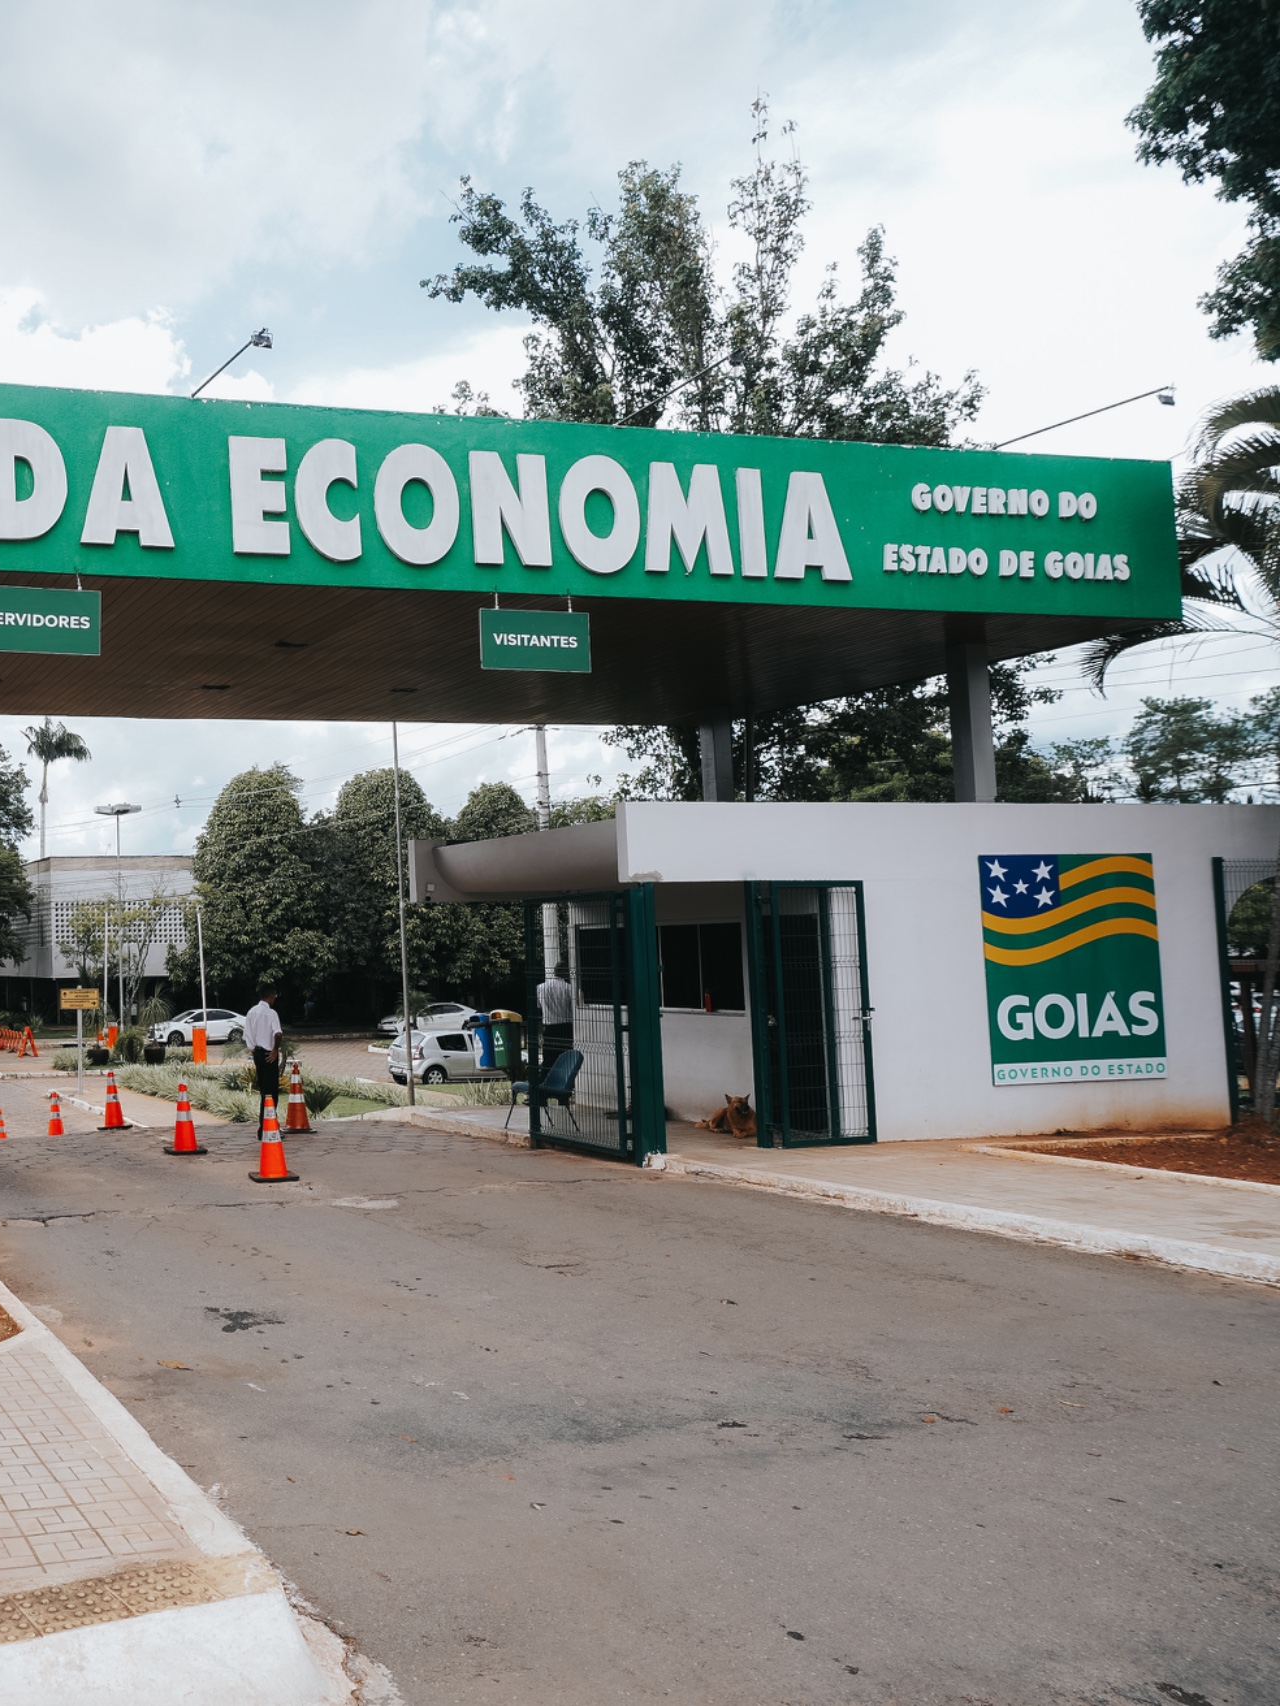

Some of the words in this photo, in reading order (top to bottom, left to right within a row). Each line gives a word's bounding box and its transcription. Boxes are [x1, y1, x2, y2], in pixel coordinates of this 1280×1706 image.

[228, 435, 853, 582] ECONOMIA
[911, 482, 1050, 519] GOVERNO
[1058, 491, 1098, 521] DO
[882, 543, 989, 577] ESTADO
[998, 549, 1035, 579] DE
[1044, 550, 1131, 582] GOIAS
[492, 632, 579, 649] VISITANTES
[996, 990, 1160, 1041] GOIÁS
[996, 1066, 1074, 1081] GOVERNO
[1080, 1064, 1101, 1077] DO
[1108, 1062, 1166, 1076] ESTADO
